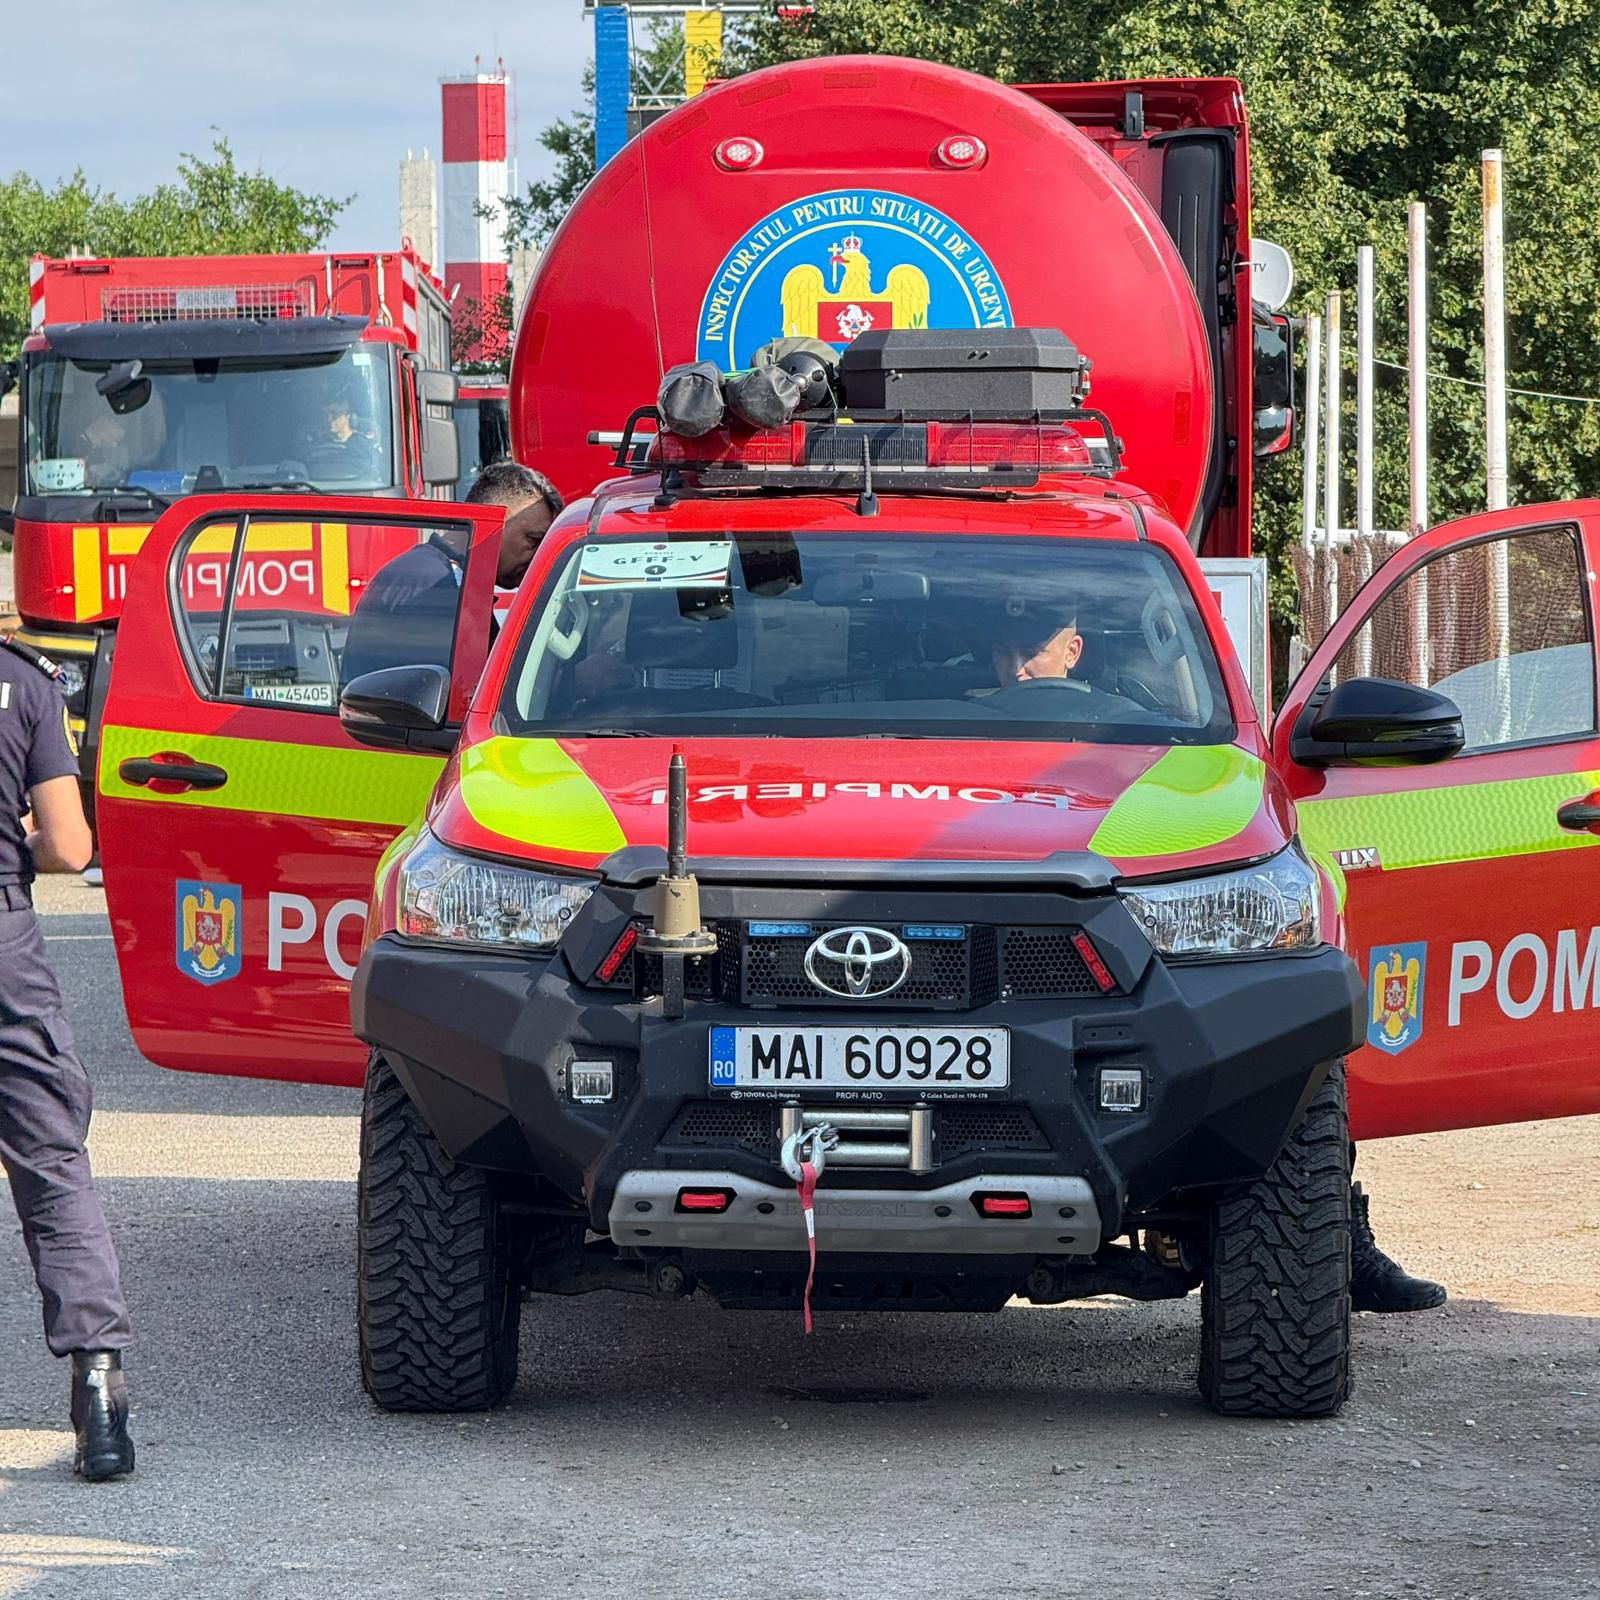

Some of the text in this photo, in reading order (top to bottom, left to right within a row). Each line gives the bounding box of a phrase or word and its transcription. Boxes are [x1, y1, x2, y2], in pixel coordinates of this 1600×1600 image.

[704, 221, 793, 342] INSPECTORATUL
[792, 196, 866, 227] PENTRU
[943, 233, 971, 260] DE
[286, 687, 329, 701] 45405
[1448, 926, 1600, 1027] POM
[713, 1061, 734, 1078] RO
[751, 1034, 992, 1080] MAI 60928
